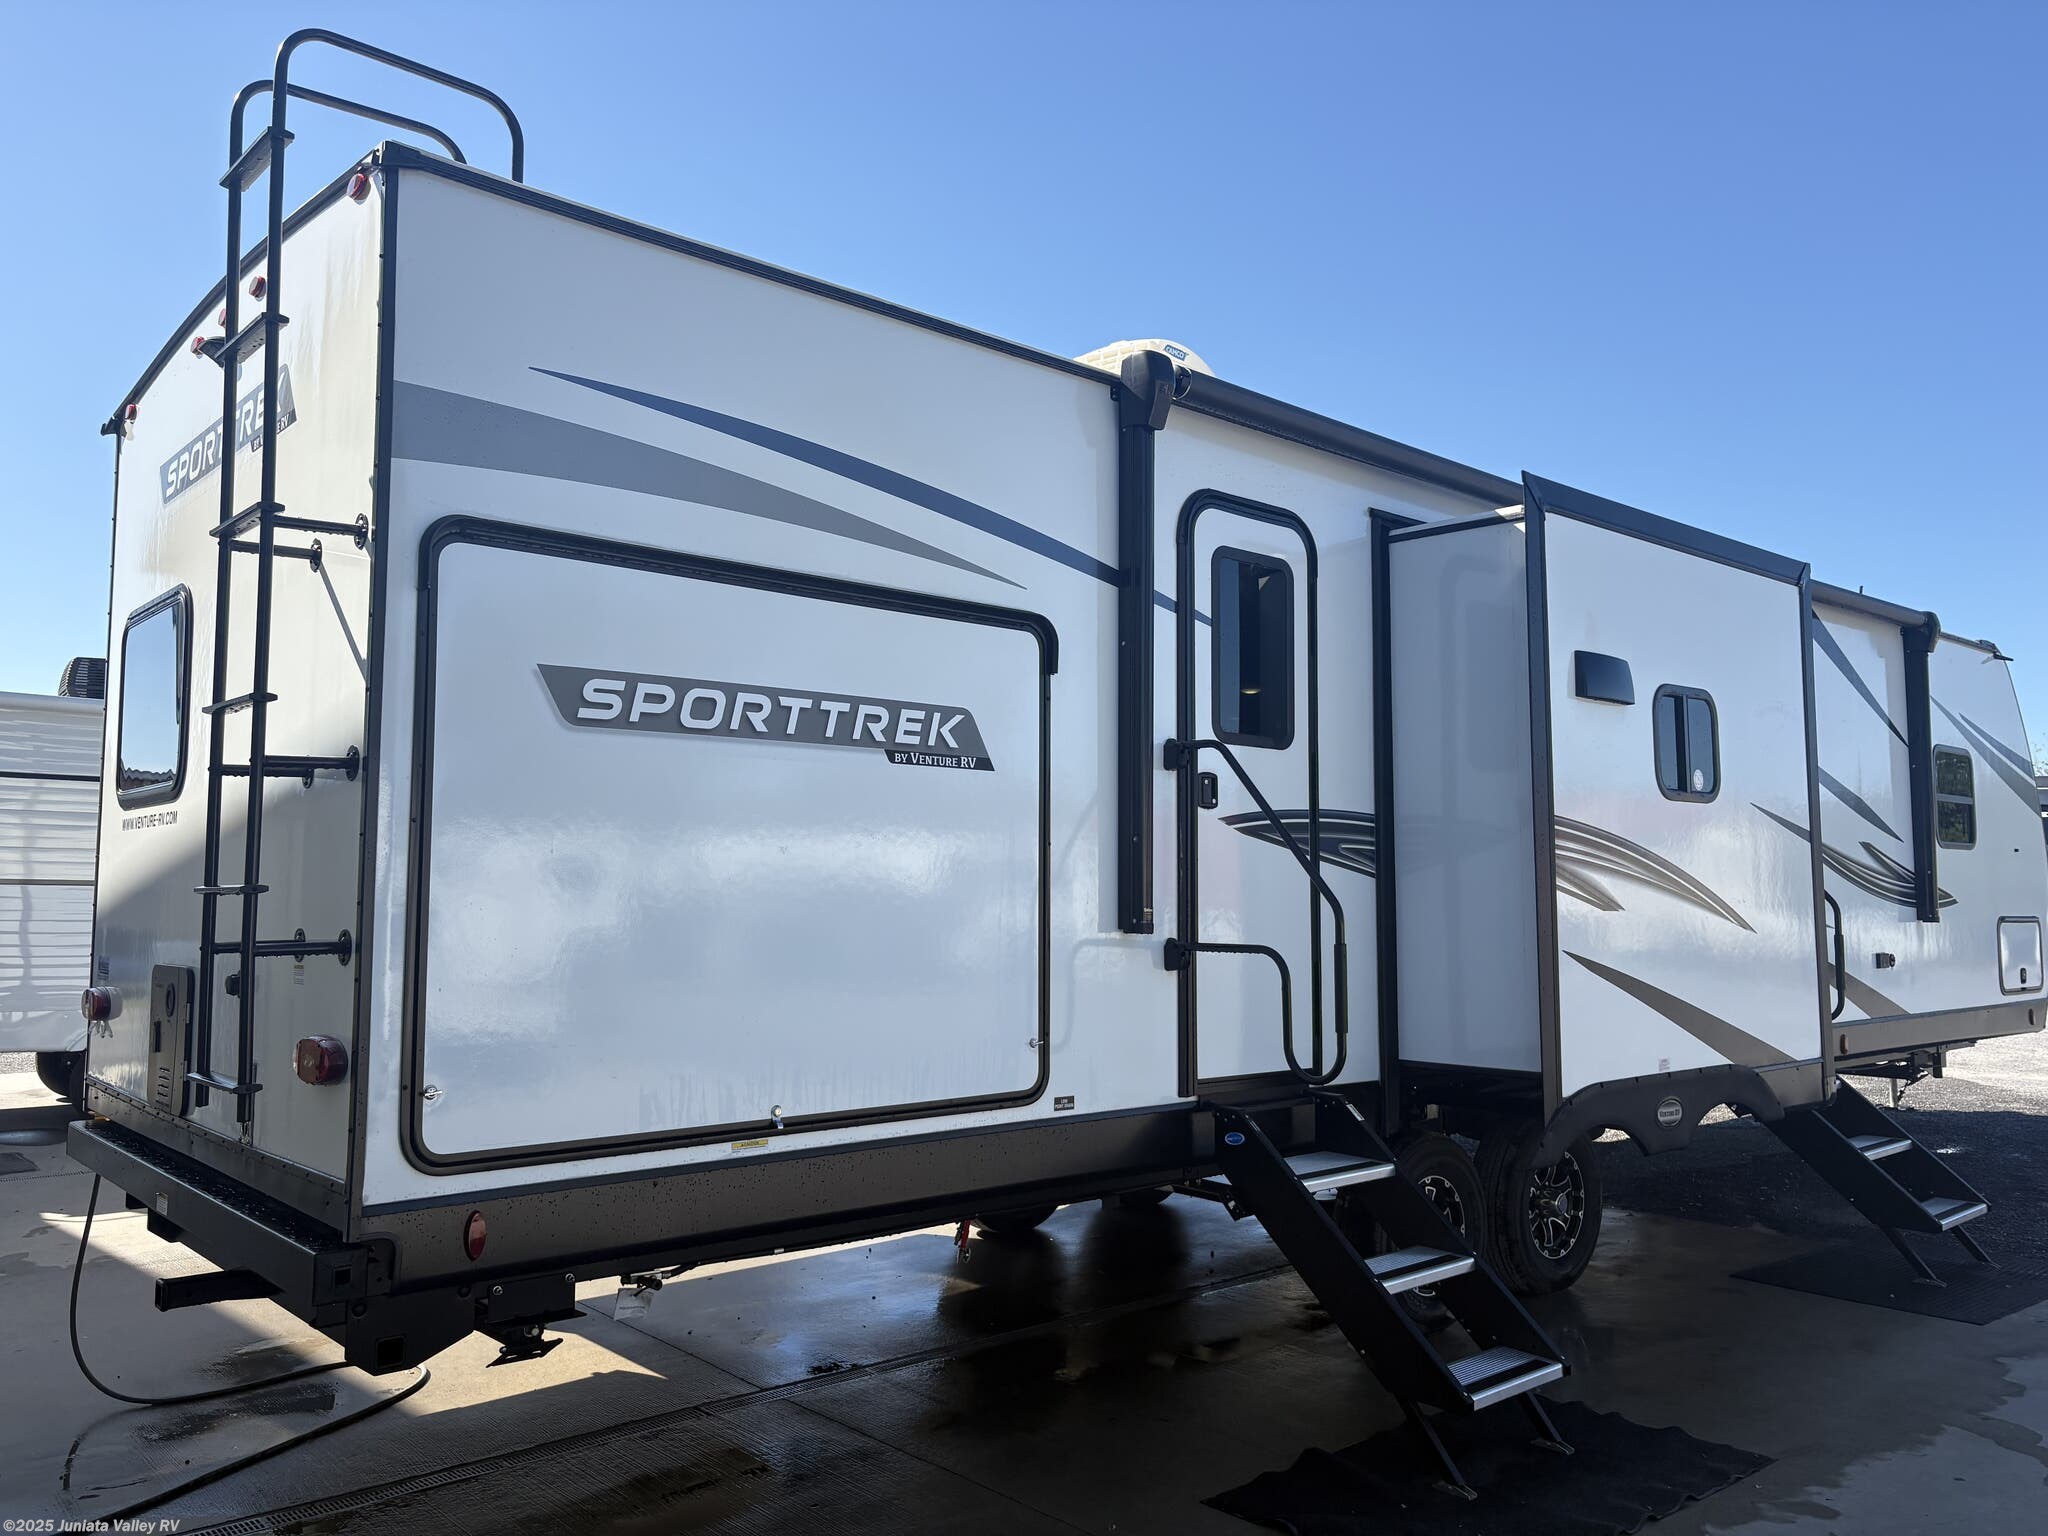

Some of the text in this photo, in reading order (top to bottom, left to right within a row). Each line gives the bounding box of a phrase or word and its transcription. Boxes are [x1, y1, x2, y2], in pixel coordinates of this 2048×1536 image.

[1165, 346, 1185, 359] CAMCO
[166, 371, 286, 498] SPORRE
[577, 678, 965, 748] SPORTTREK
[894, 752, 909, 763] BY
[960, 757, 976, 768] RV
[122, 810, 178, 831] WWW.VENTURE-RV.COM
